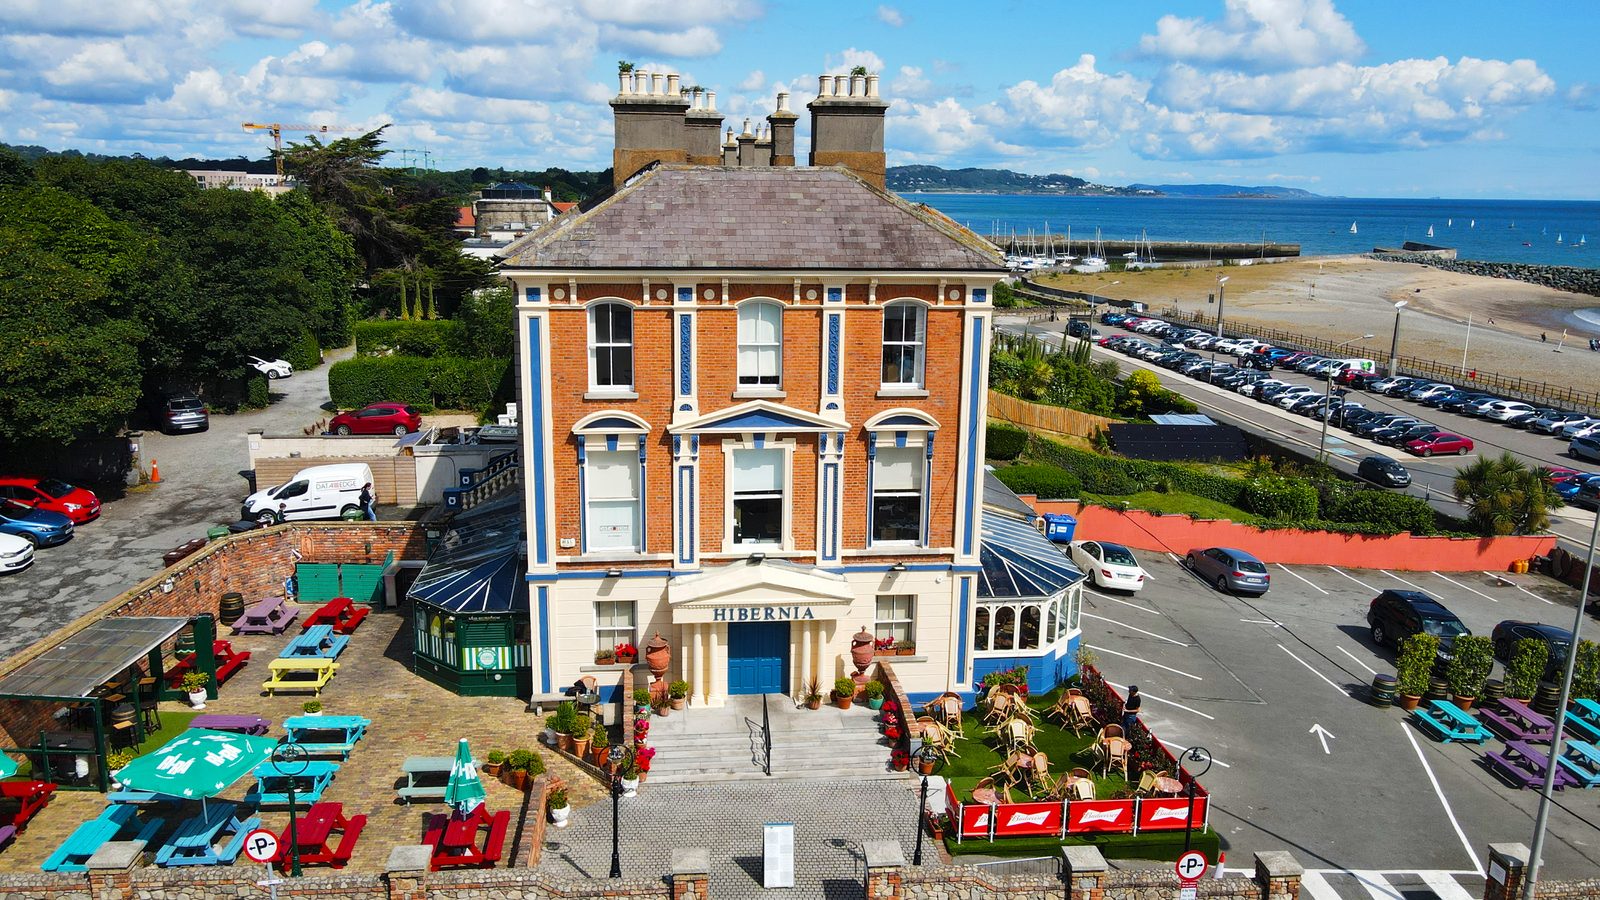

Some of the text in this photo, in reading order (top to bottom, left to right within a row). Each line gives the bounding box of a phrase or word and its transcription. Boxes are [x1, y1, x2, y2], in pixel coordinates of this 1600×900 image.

[713, 607, 814, 621] HIBERNIA
[1010, 812, 1045, 823] Budweiser
[1083, 810, 1118, 821] Budweiser
[255, 837, 268, 855] P
[1186, 858, 1198, 874] P
